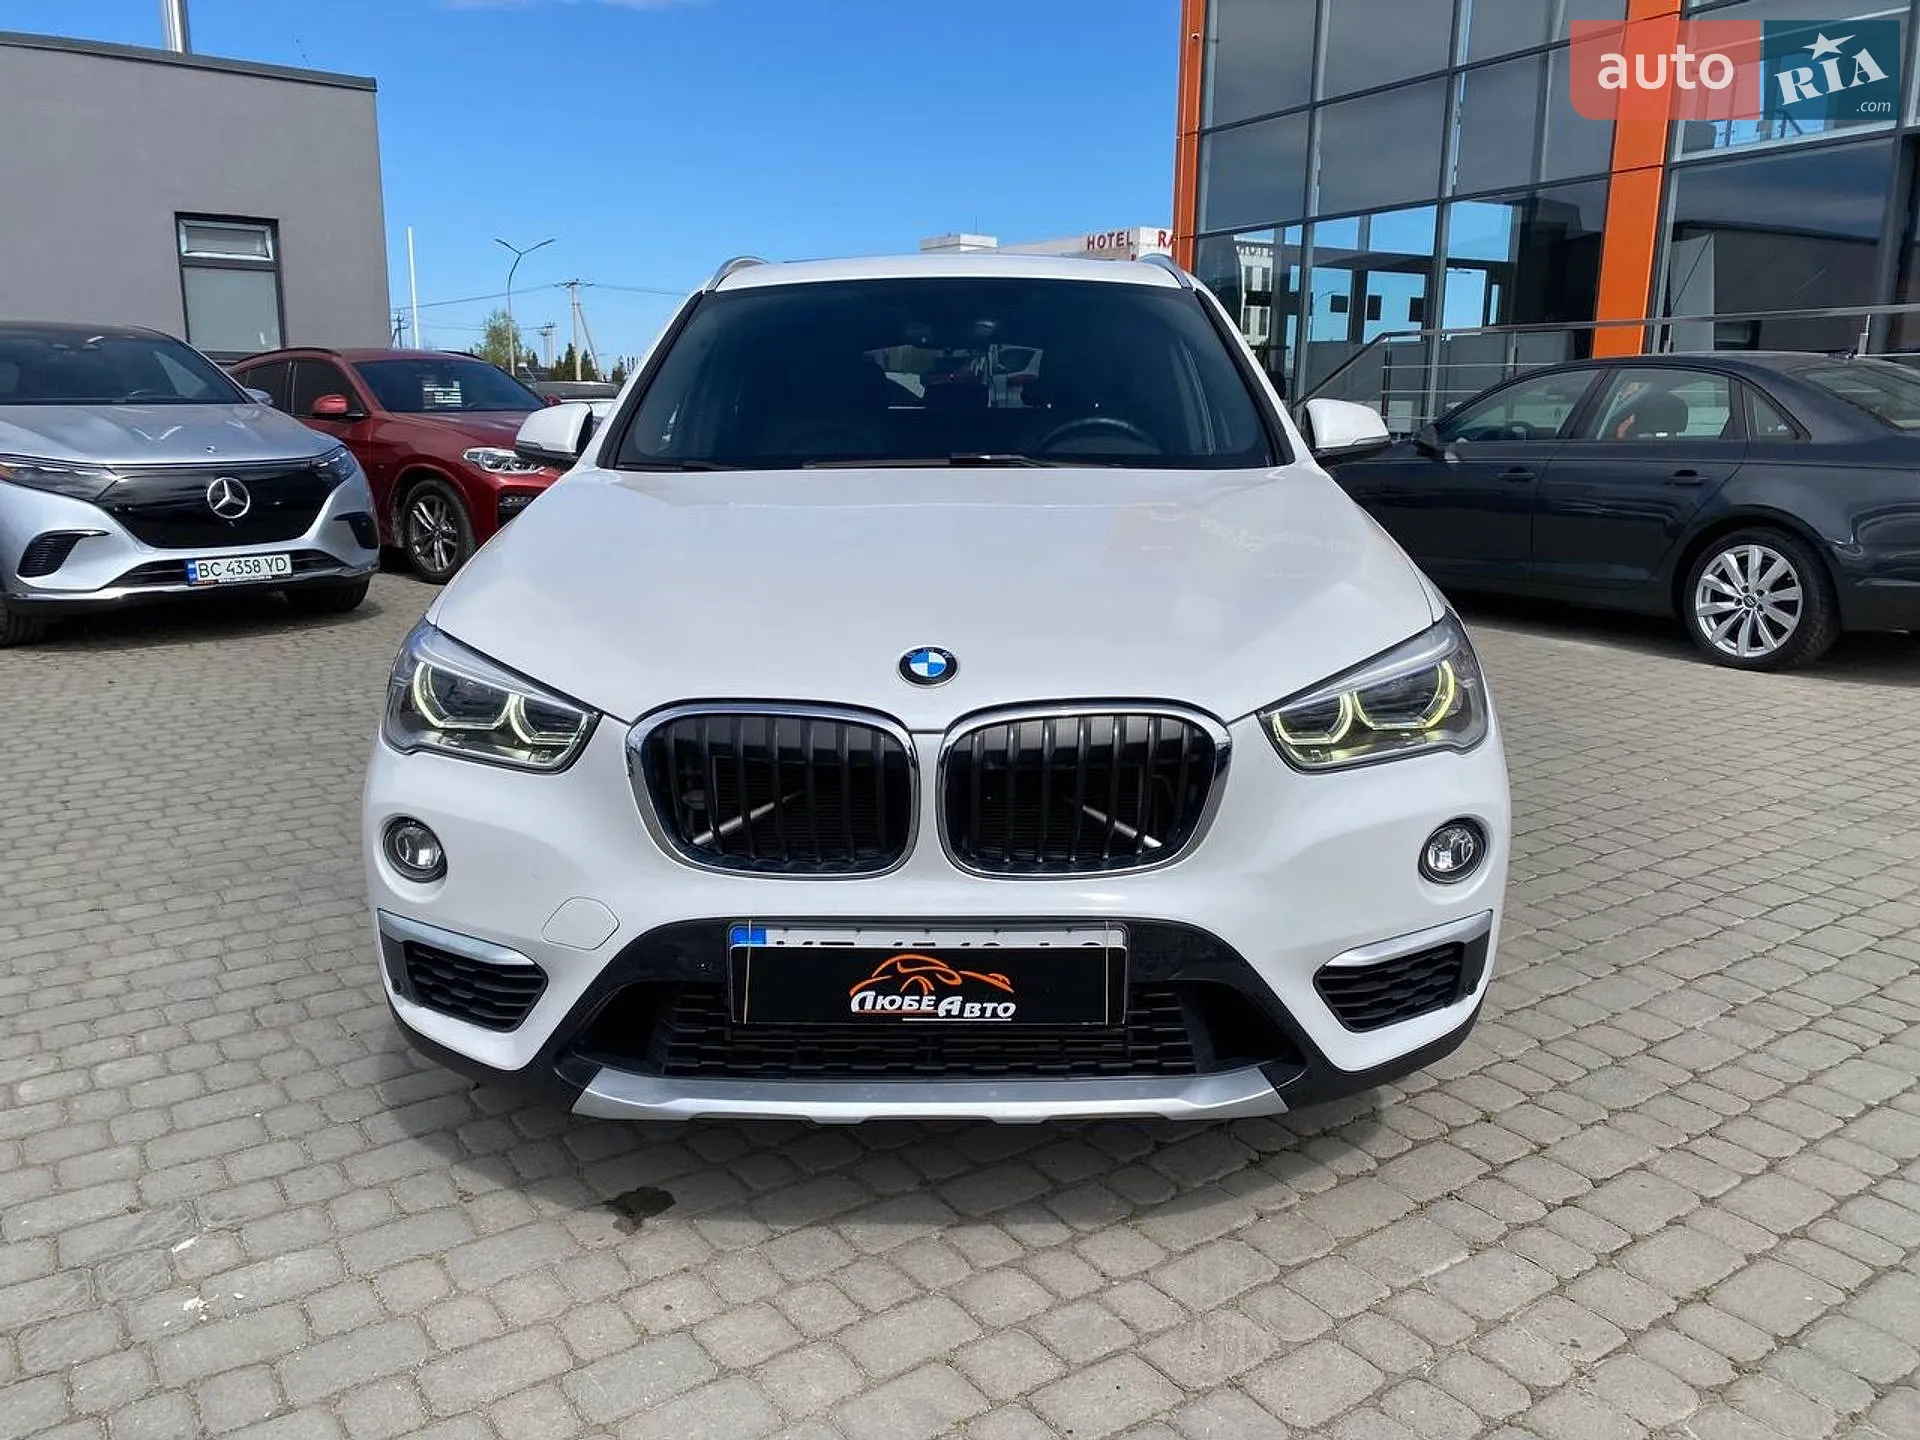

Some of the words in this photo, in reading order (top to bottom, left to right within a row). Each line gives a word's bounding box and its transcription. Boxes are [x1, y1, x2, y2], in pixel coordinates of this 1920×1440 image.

[1087, 230, 1133, 250] HOTEL
[199, 562, 221, 578] BC
[226, 559, 261, 576] 4358
[264, 557, 287, 572] YD
